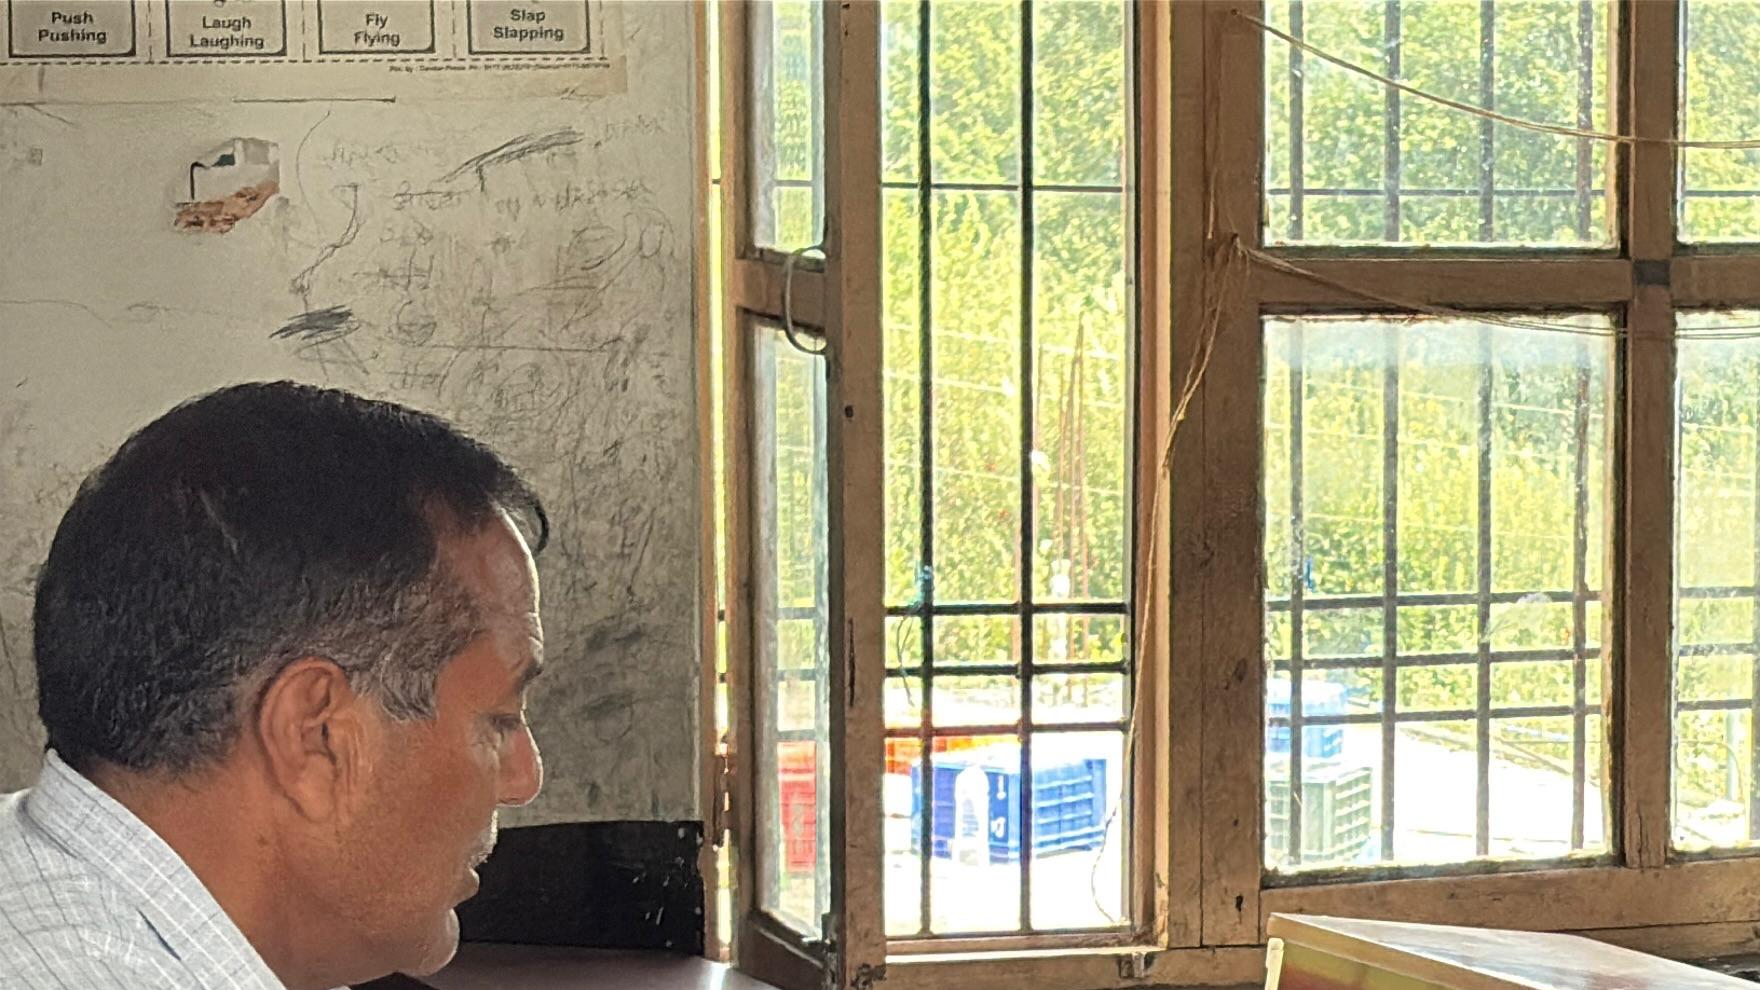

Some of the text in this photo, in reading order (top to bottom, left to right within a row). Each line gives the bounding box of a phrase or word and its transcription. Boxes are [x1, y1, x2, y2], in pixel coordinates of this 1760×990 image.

[51, 11, 93, 24] Push
[202, 15, 252, 31] Laugh
[365, 13, 388, 29] Fly
[510, 9, 546, 23] Slap
[38, 28, 107, 44] Pushing
[190, 33, 264, 50] Laughing
[354, 30, 400, 47] Flying
[493, 26, 564, 42] Slapping
